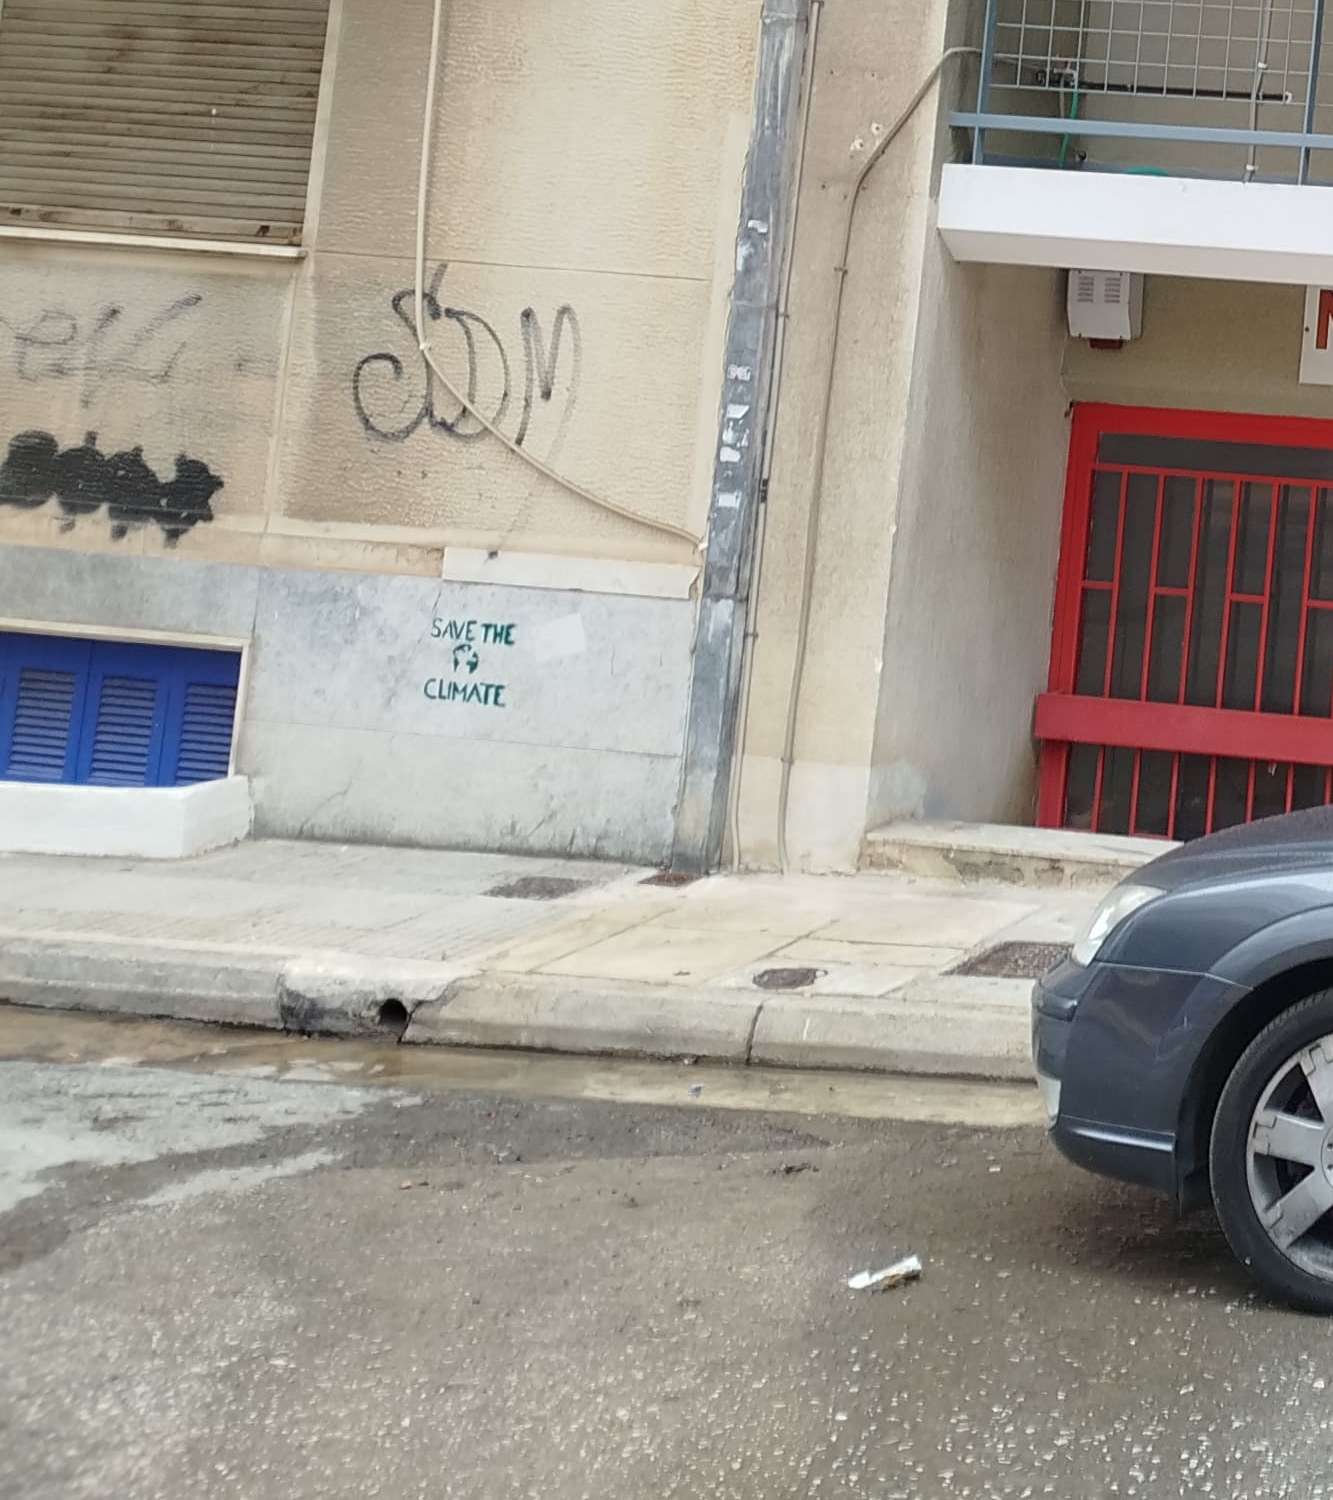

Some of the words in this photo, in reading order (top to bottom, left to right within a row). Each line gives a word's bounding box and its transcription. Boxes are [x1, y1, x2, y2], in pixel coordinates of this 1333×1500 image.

[430, 617, 477, 642] SAVE
[481, 623, 517, 646] THE
[423, 678, 507, 708] CLIMATE
